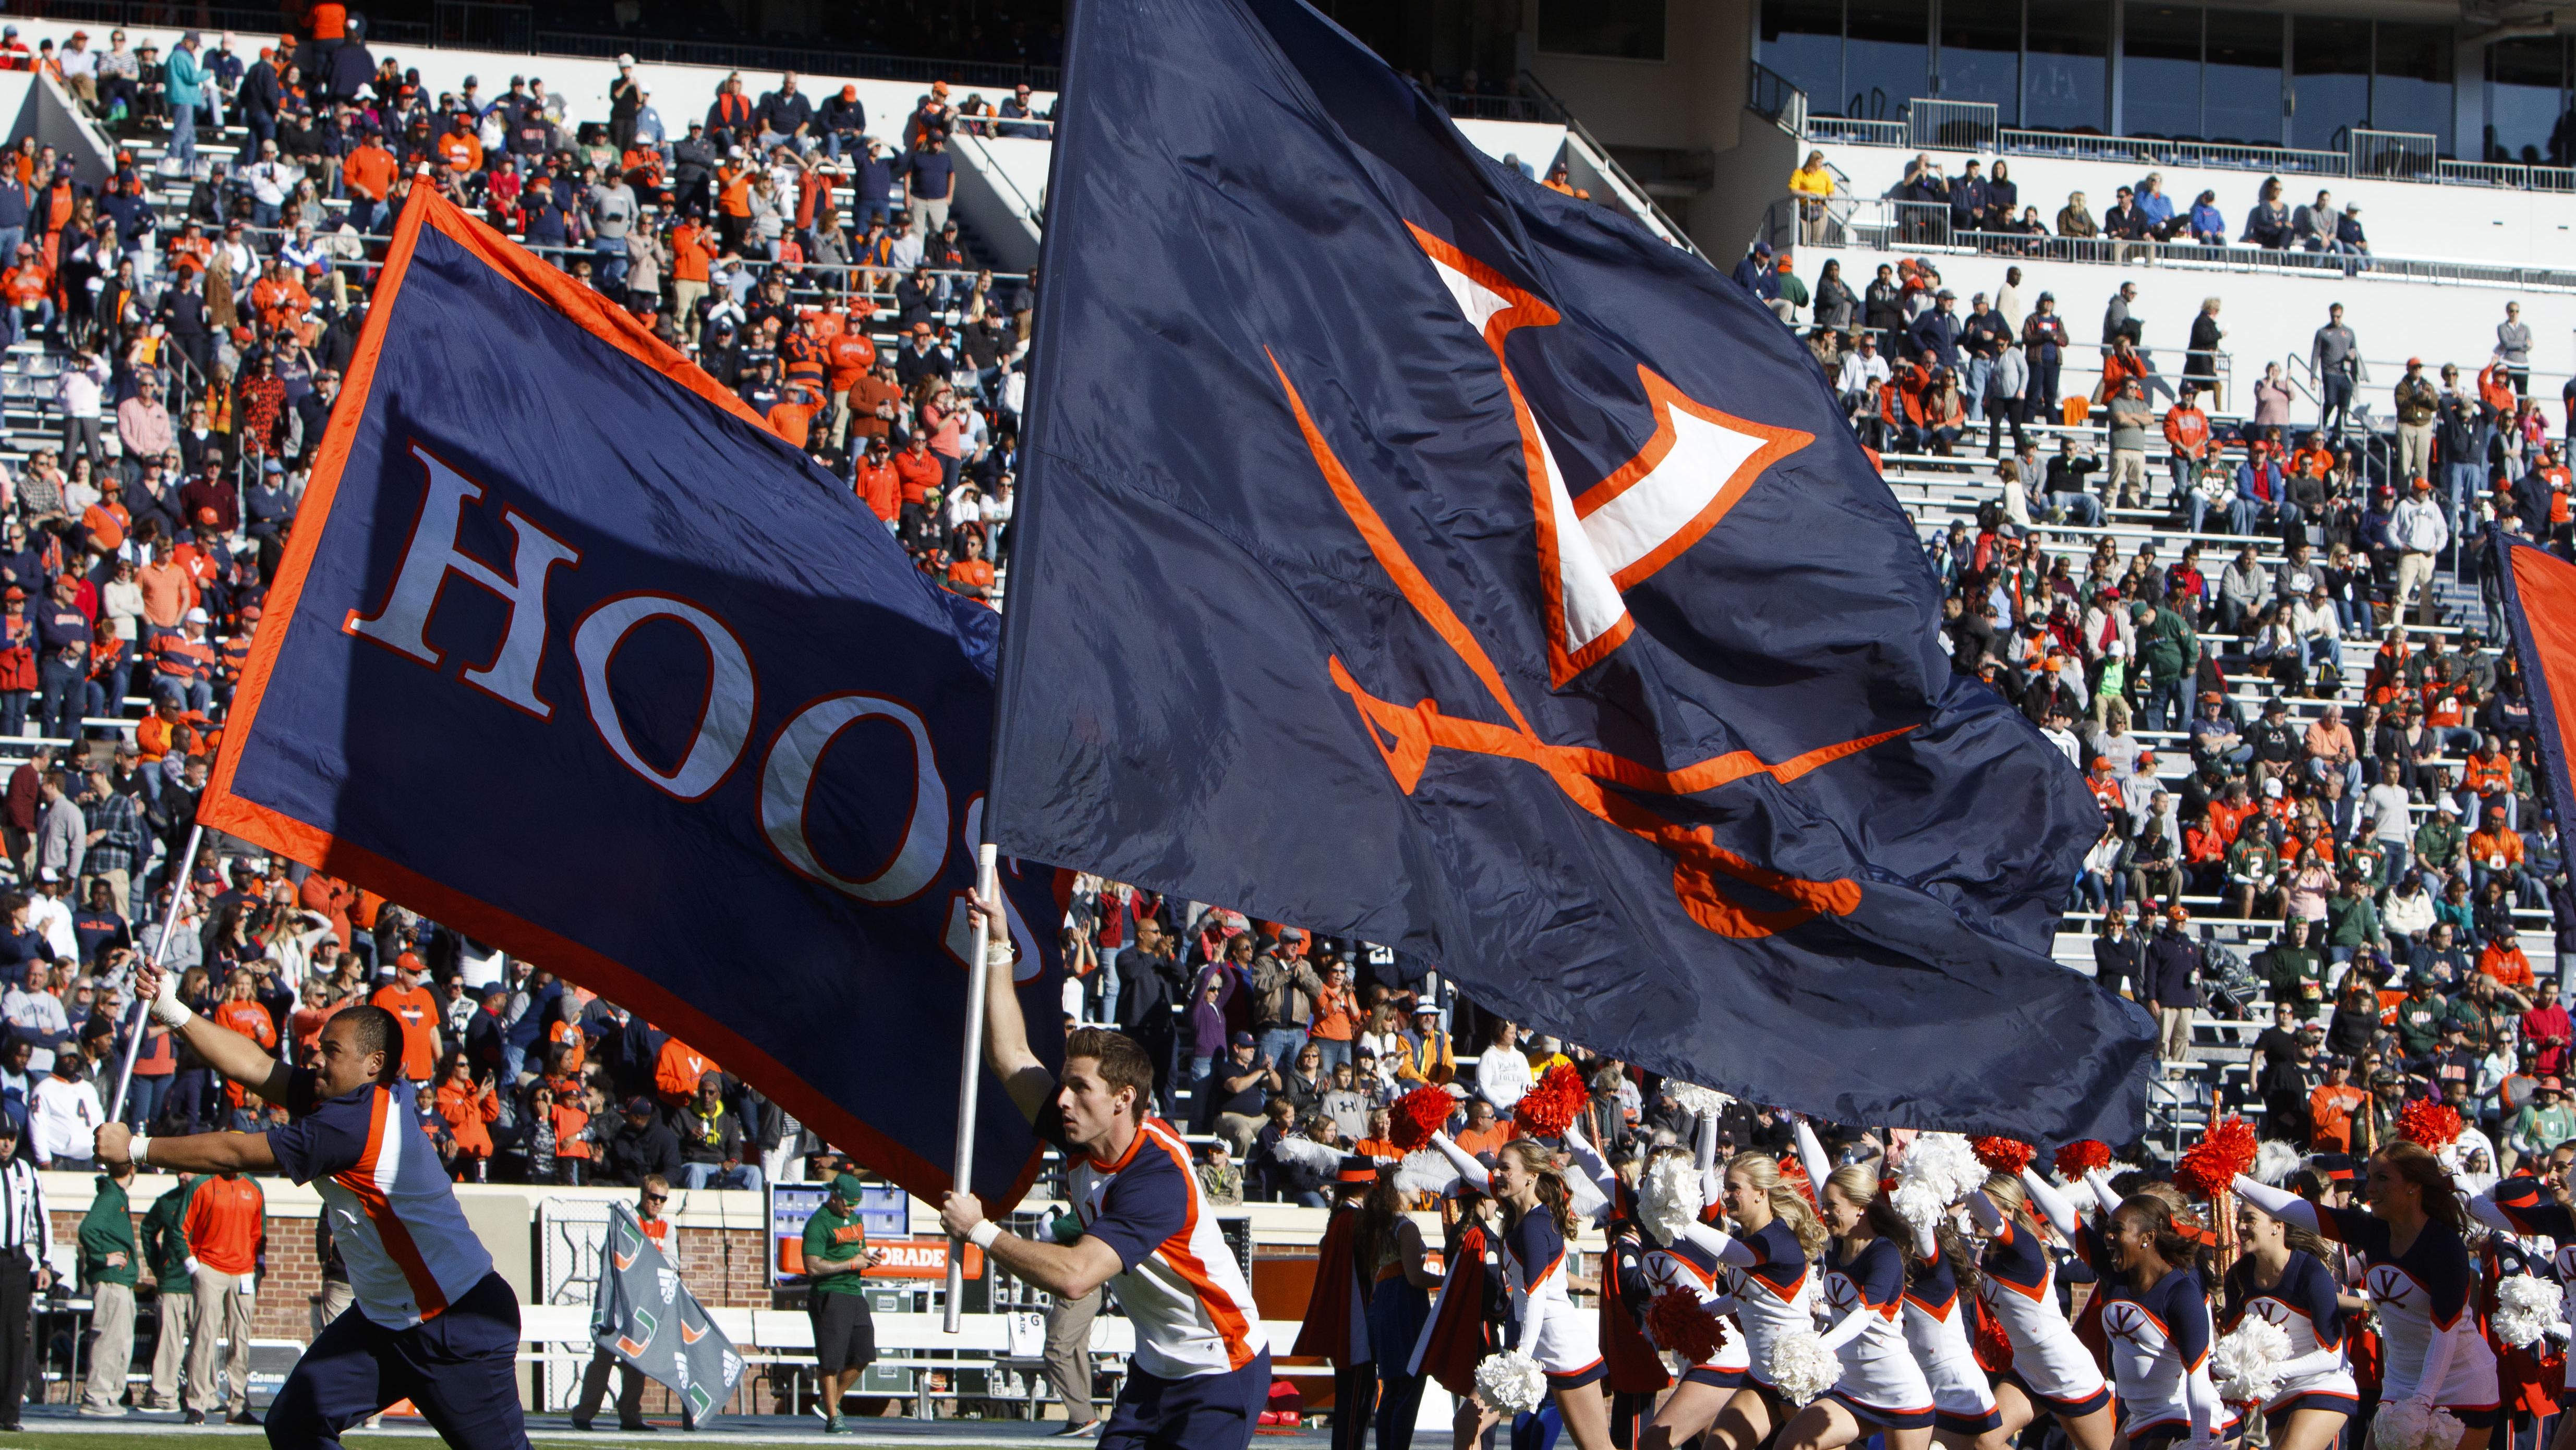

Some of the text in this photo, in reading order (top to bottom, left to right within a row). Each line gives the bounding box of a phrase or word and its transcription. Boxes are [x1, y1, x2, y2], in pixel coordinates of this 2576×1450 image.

[2202, 477, 2225, 496] 85
[2250, 857, 2263, 878] 2
[2359, 857, 2372, 877] 9
[77, 1098, 91, 1128] 4
[867, 1247, 946, 1268] ORADE
[1031, 1314, 1039, 1326] G
[615, 1306, 658, 1359] U
[217, 1370, 285, 1384] CoComm
[724, 1357, 743, 1387] adidas
